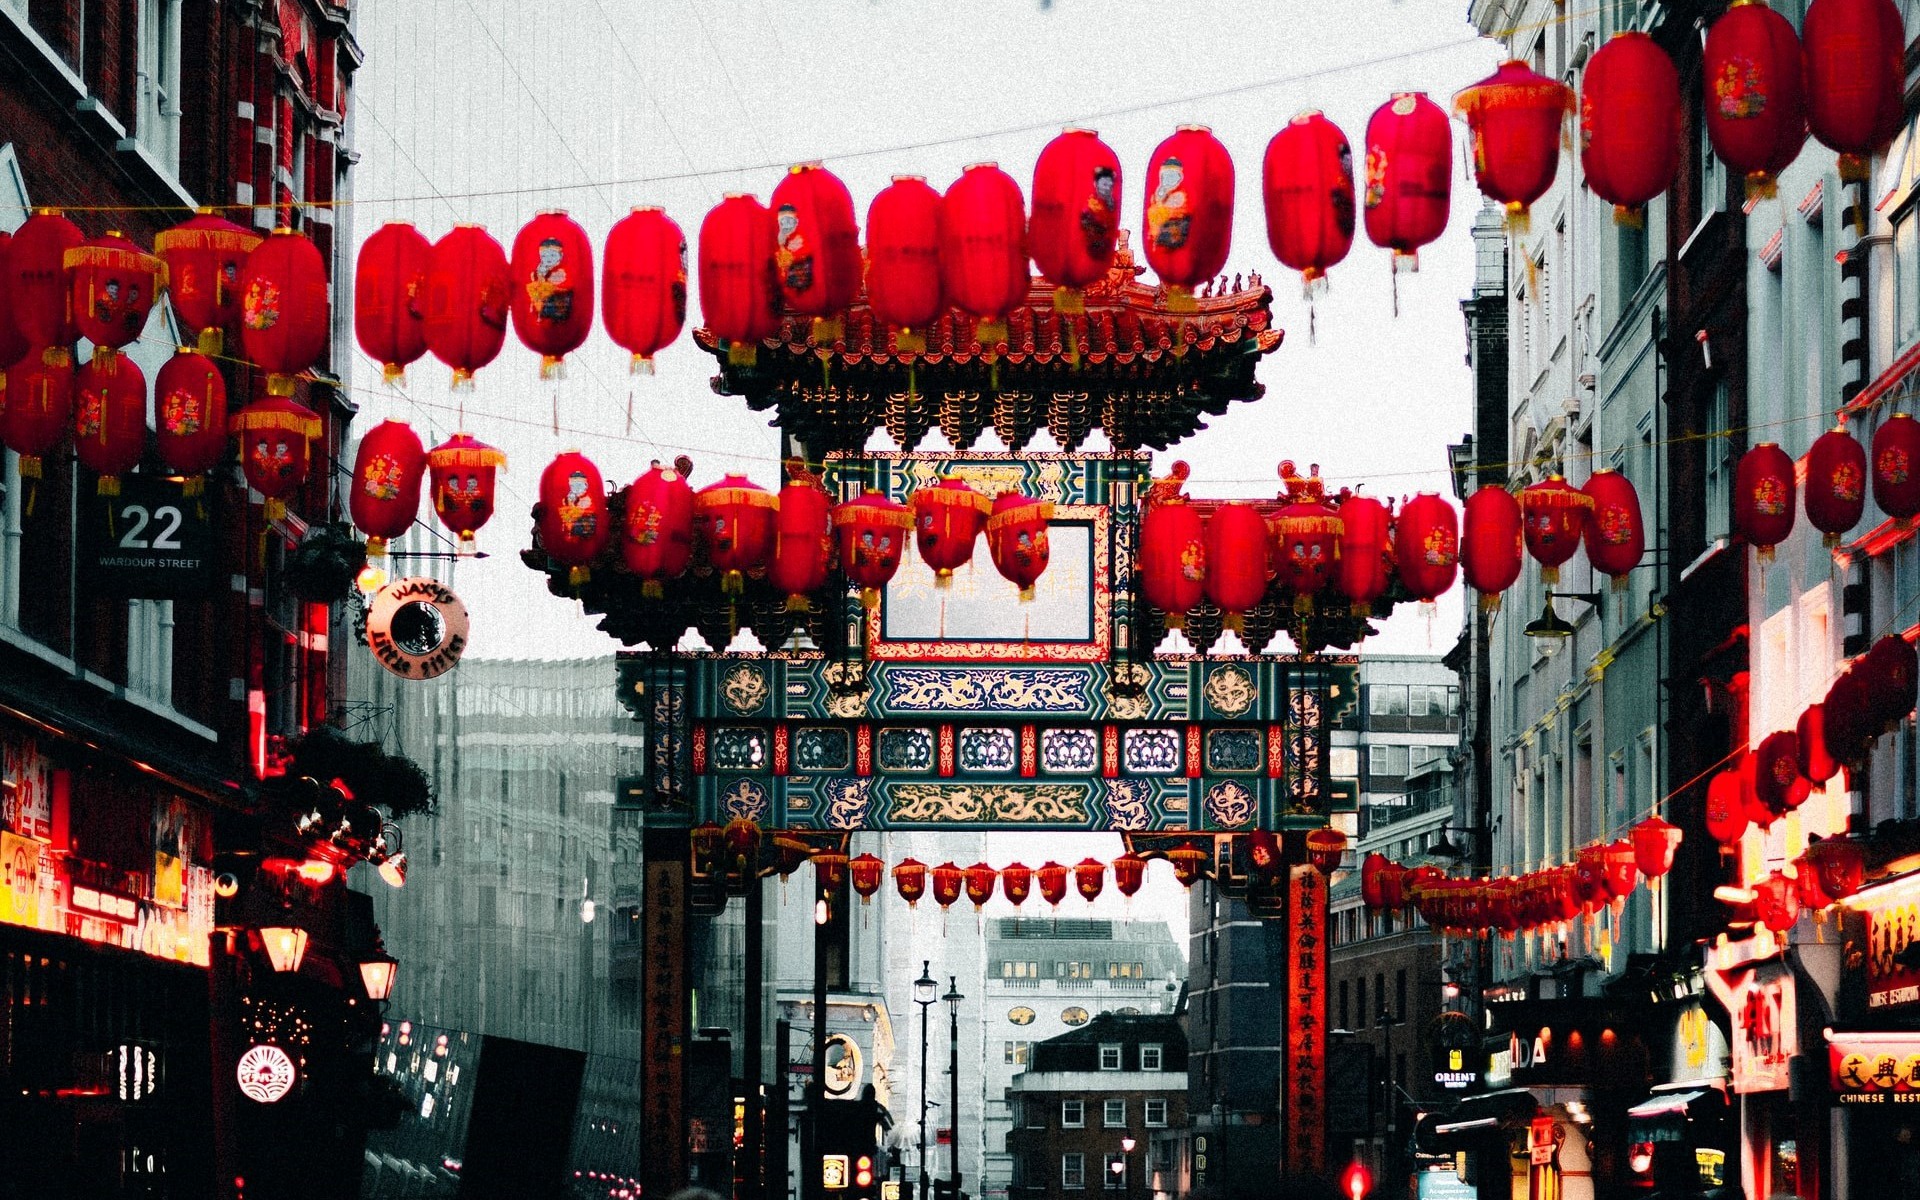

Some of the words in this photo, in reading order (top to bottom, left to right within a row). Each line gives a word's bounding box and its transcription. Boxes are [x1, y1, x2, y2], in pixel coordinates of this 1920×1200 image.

[119, 504, 182, 549] 22
[99, 557, 156, 568] WARDOUR
[158, 559, 201, 568] STREET
[1435, 1073, 1476, 1082] ORIENT
[1840, 1094, 1885, 1103] CHINESE
[1894, 1094, 1920, 1103] REST
